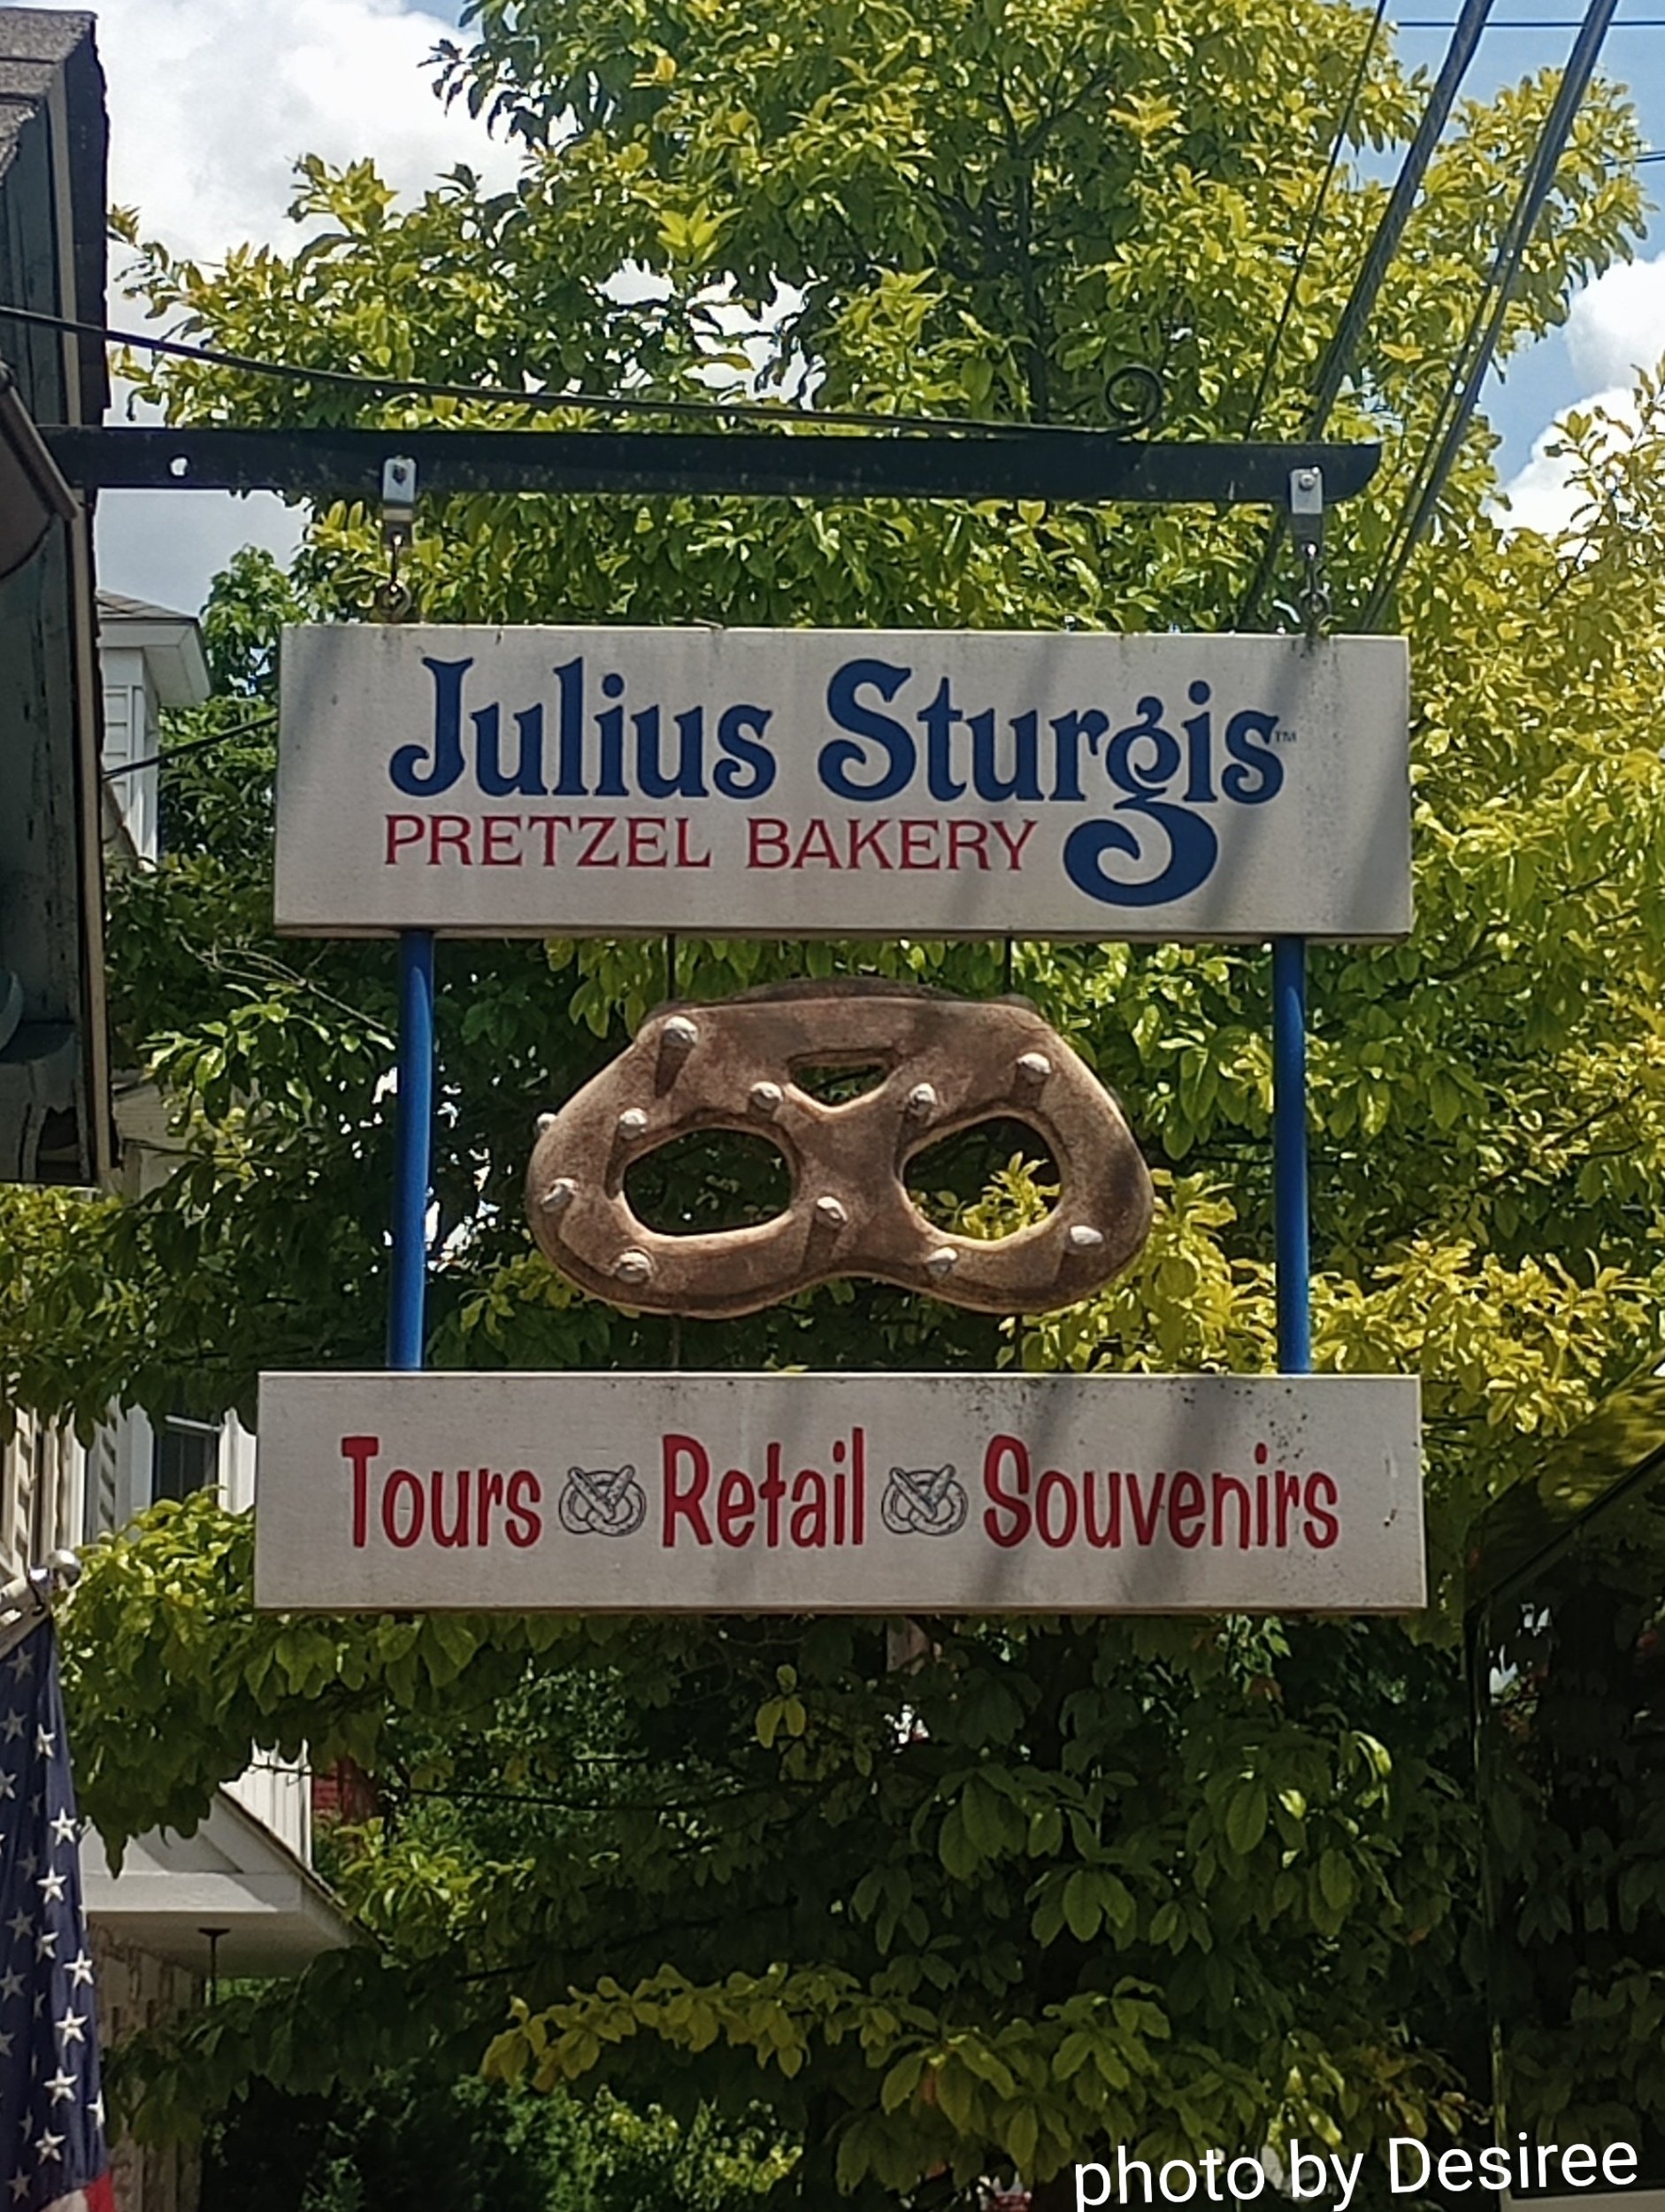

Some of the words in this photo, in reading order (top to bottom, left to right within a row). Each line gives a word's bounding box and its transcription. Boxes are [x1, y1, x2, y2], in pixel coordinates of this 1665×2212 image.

[385, 815, 711, 867] PRETZEL
[748, 819, 1038, 870] BAKERY
[389, 657, 777, 800] Julius
[818, 659, 1285, 907] Sturgis
[341, 1435, 542, 1549] Tours
[662, 1428, 867, 1550] Retail
[983, 1434, 1339, 1551] Souvenirs
